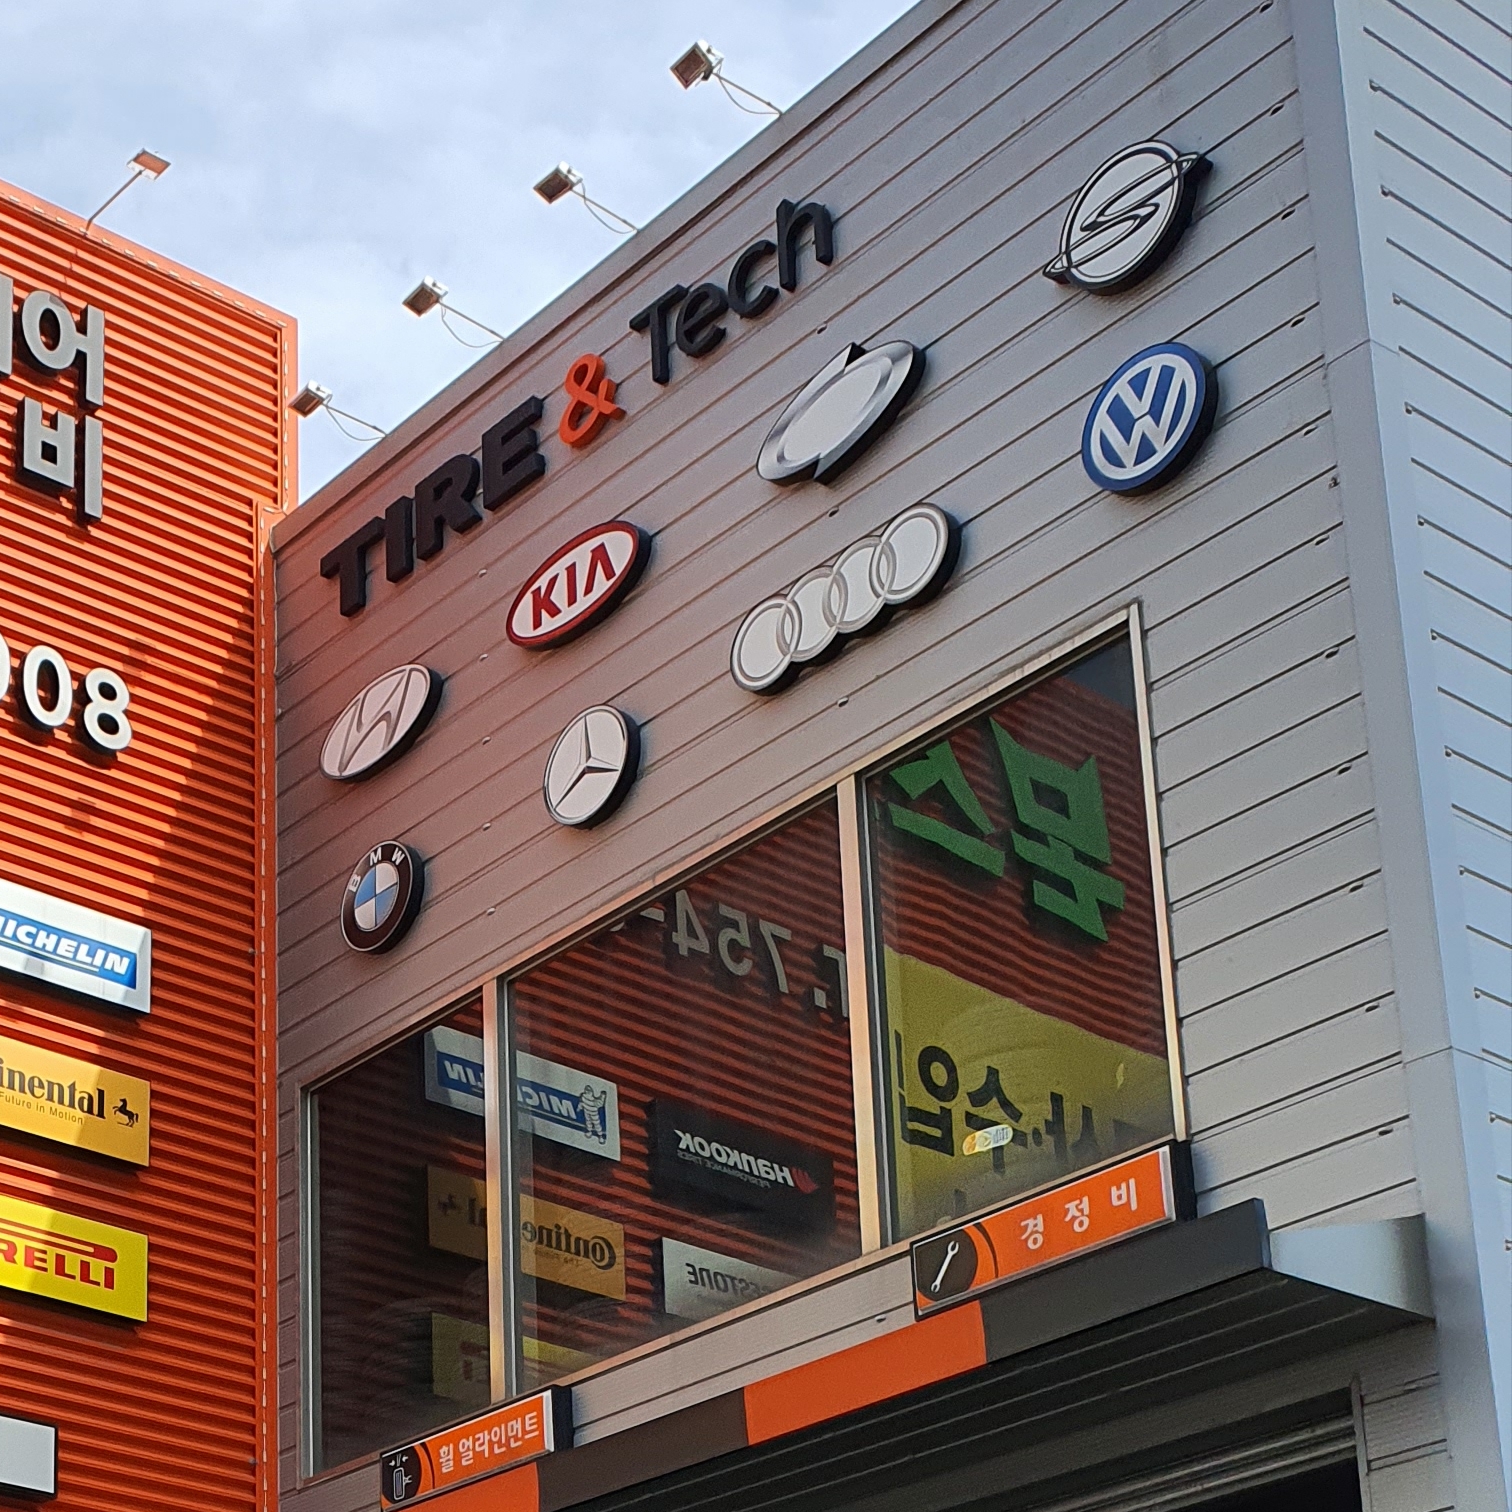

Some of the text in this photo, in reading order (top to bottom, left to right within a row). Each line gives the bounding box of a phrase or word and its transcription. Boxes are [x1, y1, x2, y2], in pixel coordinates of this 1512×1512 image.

[320, 198, 834, 617] TIRE & Tech
[528, 544, 614, 632] KIA
[348, 846, 406, 893] BMW
[36, 1101, 46, 1114] in
[49, 1106, 84, 1126] Motion
[439, 1411, 539, 1474] 휠 얼라인먼트
